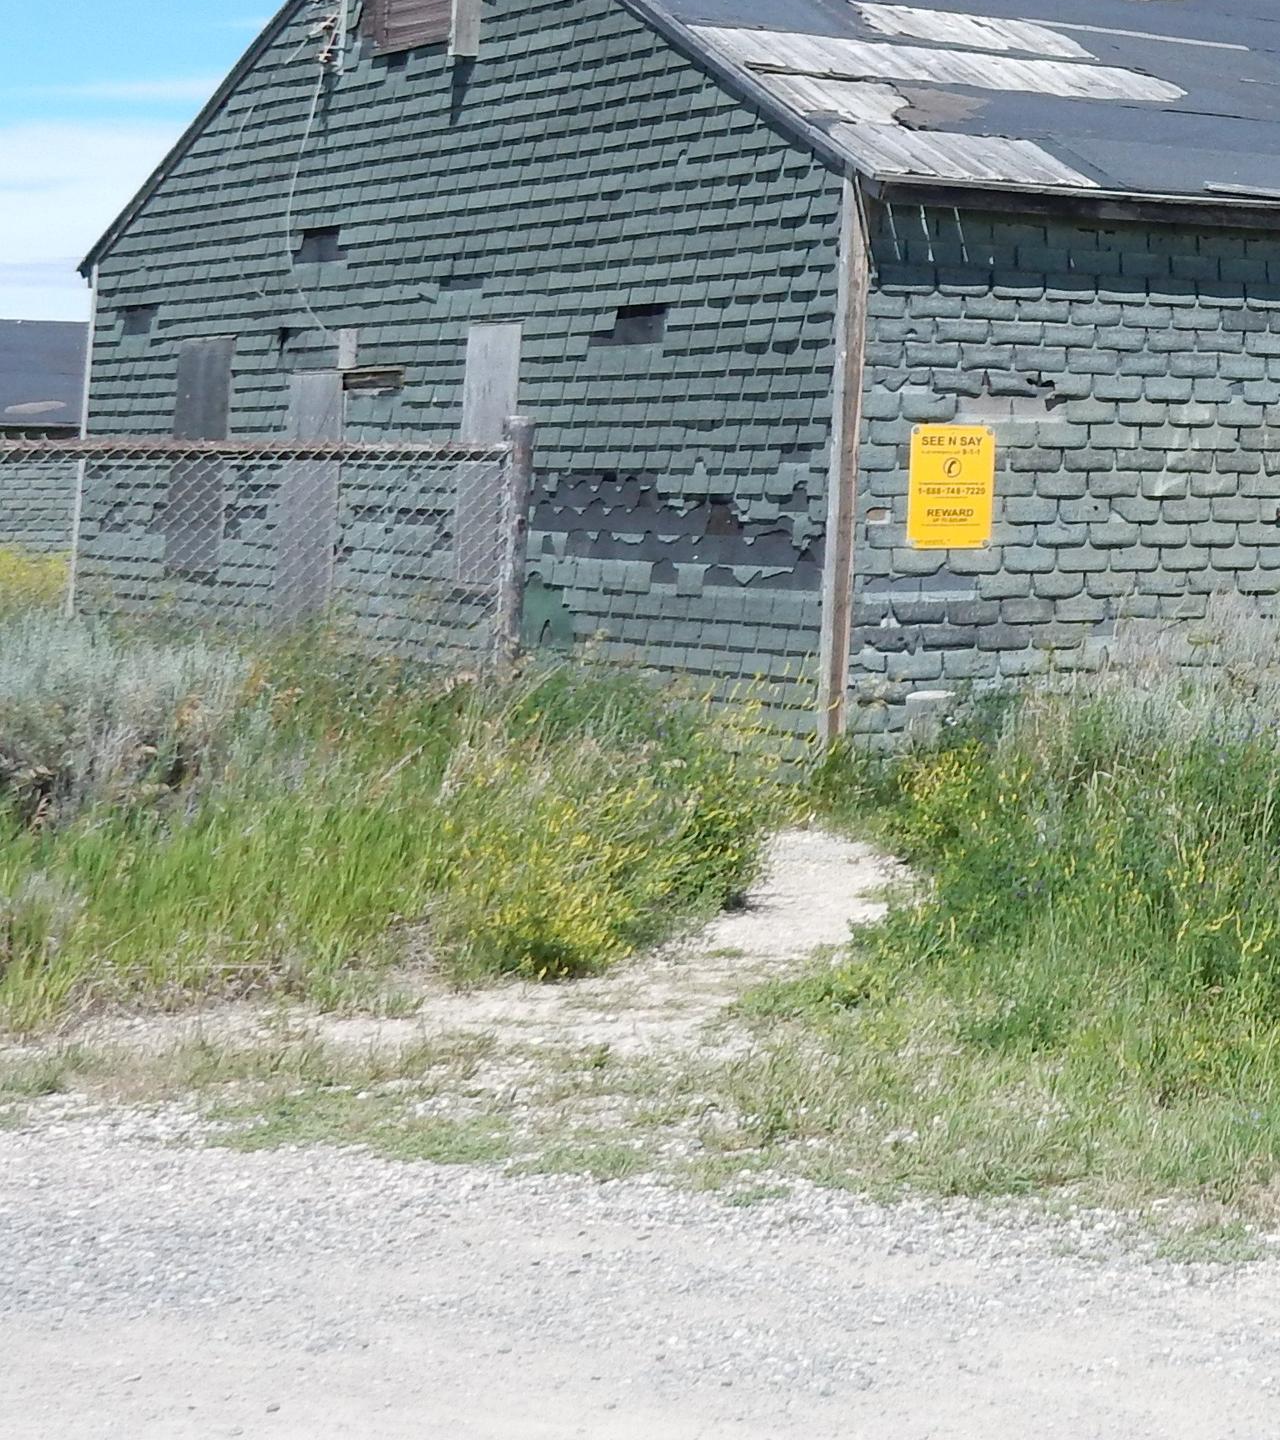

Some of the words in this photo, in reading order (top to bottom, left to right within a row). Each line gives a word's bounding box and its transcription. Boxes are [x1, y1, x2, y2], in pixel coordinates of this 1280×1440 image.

[922, 436, 945, 446] SEE
[949, 436, 957, 446] N
[960, 436, 982, 446] SAY
[927, 509, 974, 517] REWARD
